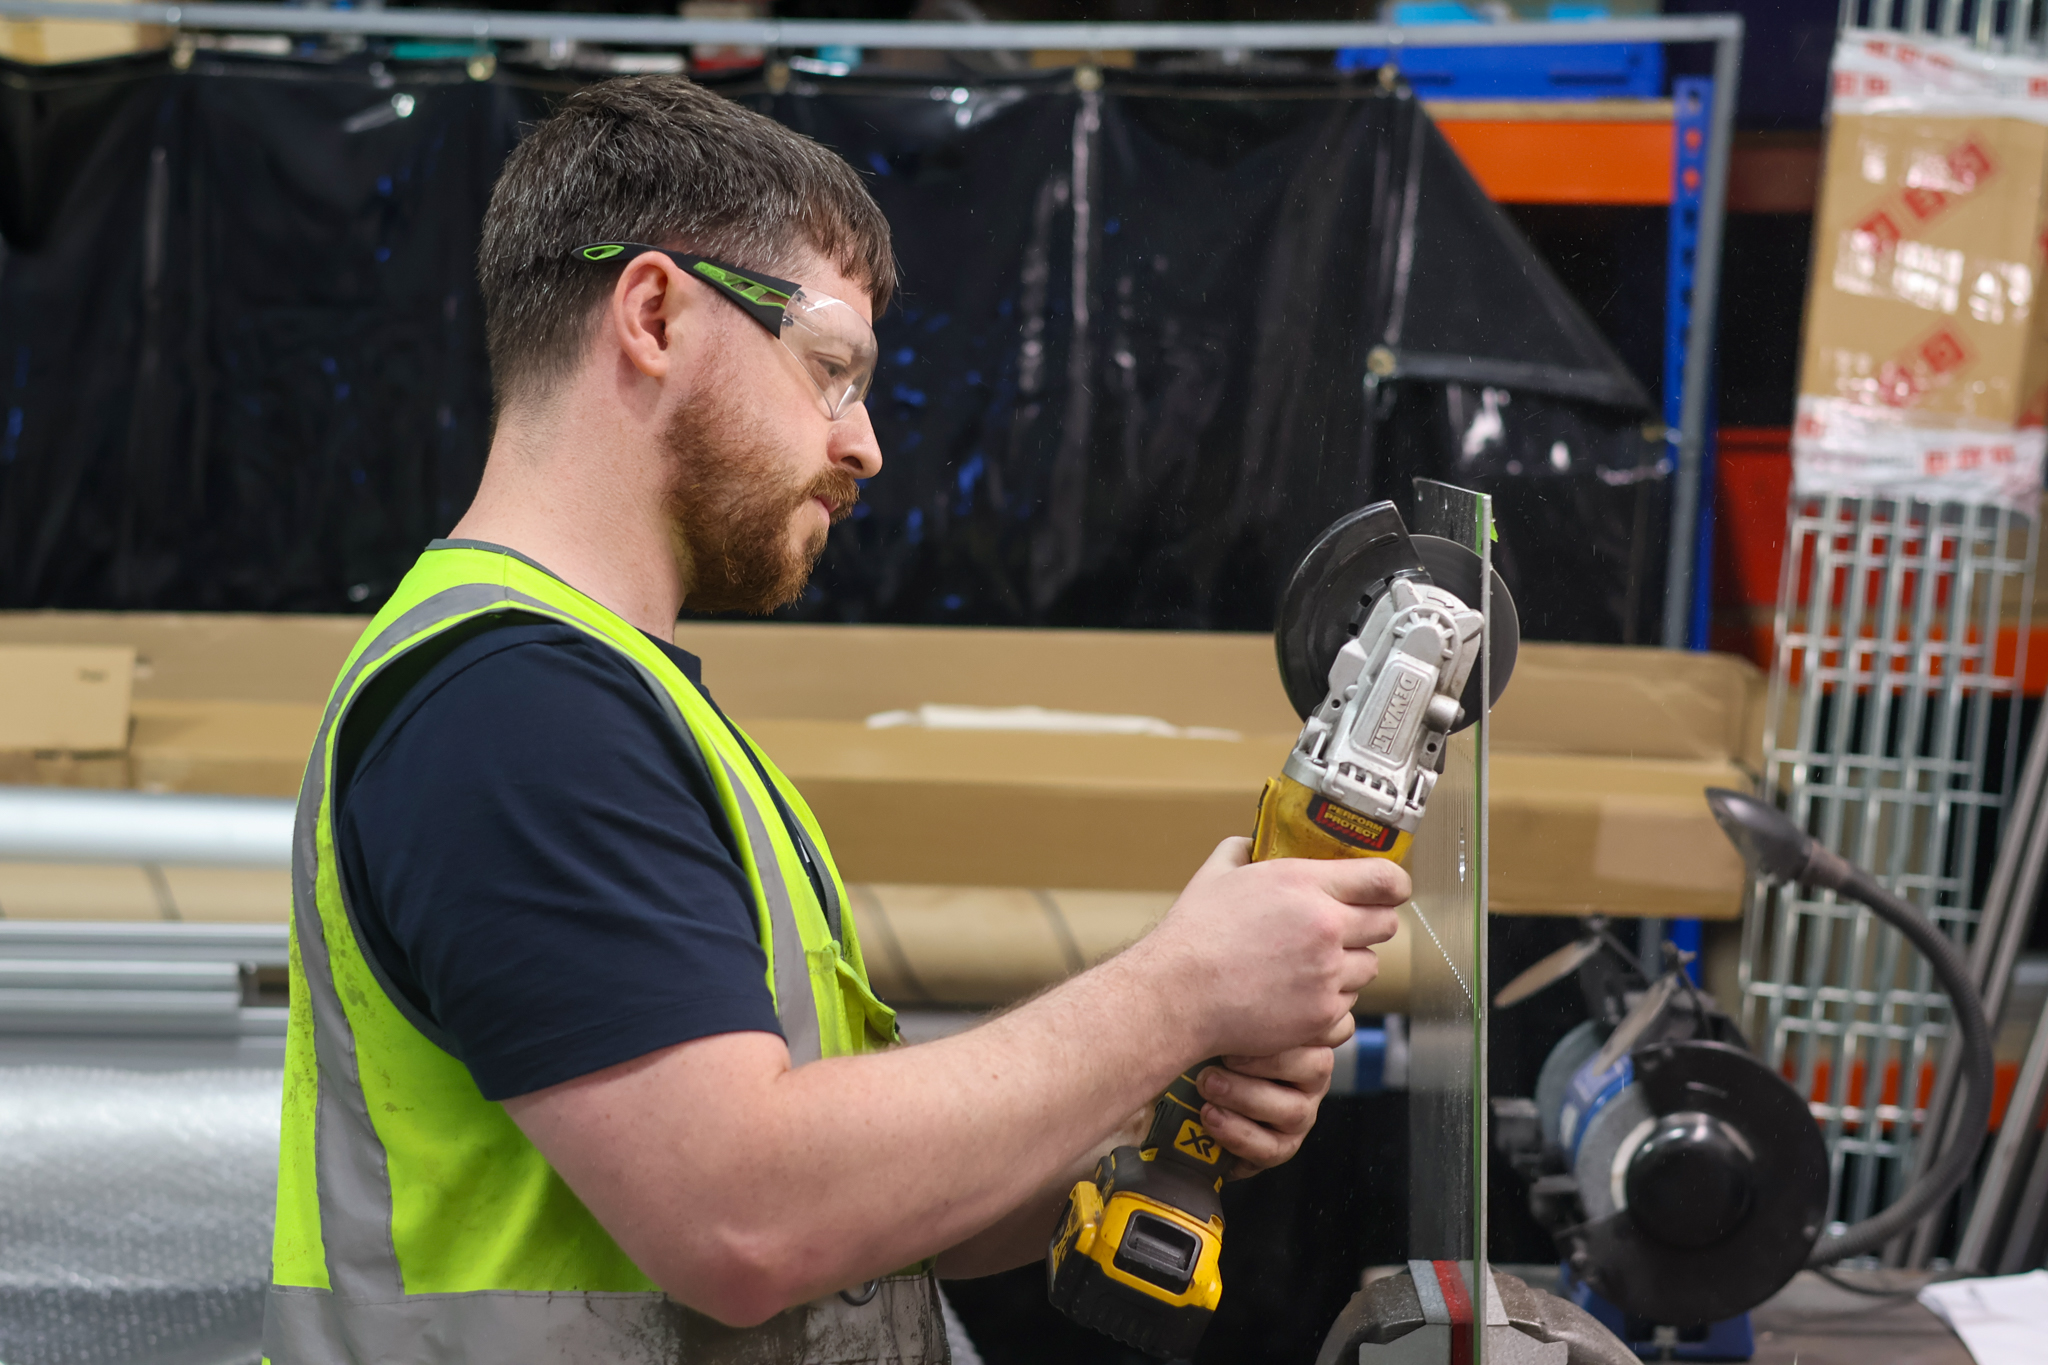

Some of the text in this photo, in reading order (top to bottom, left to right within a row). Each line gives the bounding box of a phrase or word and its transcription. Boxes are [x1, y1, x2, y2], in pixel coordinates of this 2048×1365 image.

[1371, 672, 1420, 754] DEWALT
[1323, 812, 1379, 840] PROTECT
[1327, 803, 1384, 833] PERFORM
[1179, 1126, 1215, 1159] XR
